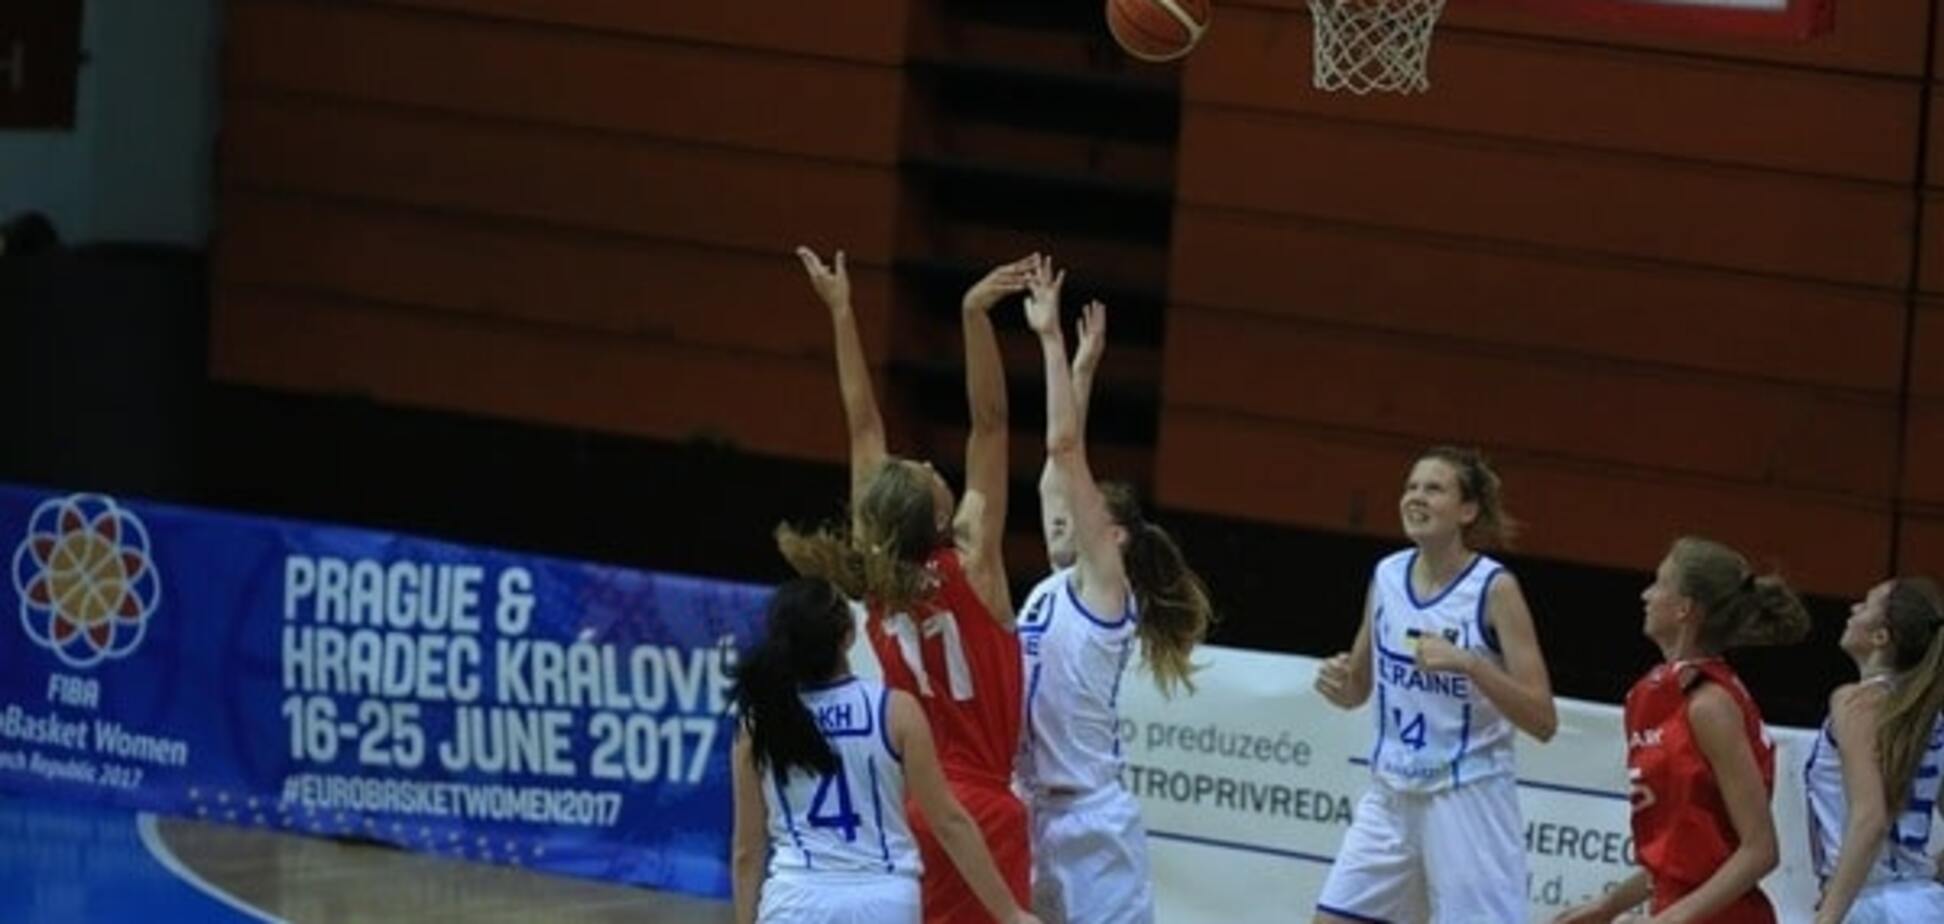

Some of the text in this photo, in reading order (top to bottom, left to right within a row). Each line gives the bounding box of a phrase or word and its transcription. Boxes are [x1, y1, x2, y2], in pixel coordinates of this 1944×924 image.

[284, 554, 535, 635] PRAGUE &
[48, 672, 100, 709] FIBA
[282, 625, 481, 702] HRADEC
[94, 719, 190, 767] Women
[282, 696, 719, 785] 16-25 JUNE 2017
[1146, 721, 1312, 767] preduzeće
[100, 762, 144, 789] 2017
[282, 773, 622, 827] #EUROBASKETWOMEN2017
[807, 752, 862, 843] 4
